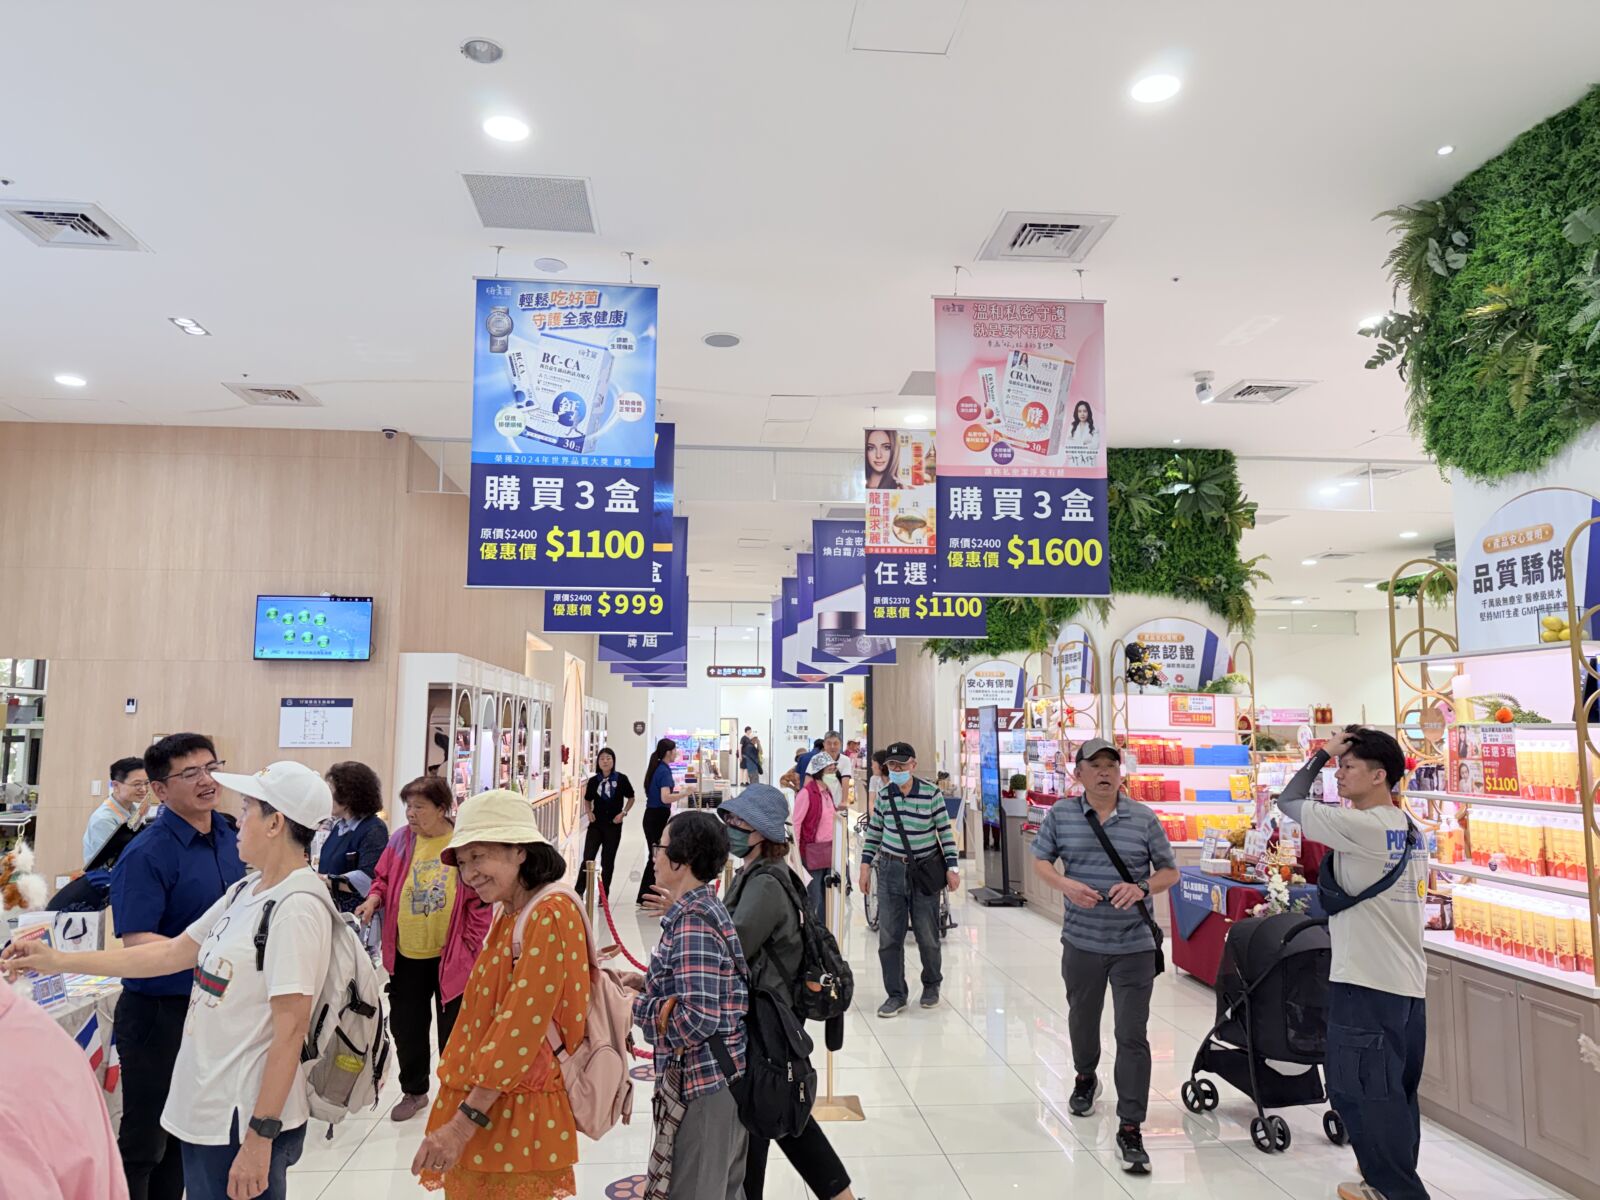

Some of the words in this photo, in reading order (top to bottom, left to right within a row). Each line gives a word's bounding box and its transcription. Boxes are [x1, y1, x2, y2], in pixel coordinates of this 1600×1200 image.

[518, 290, 600, 308] 輕鬆吃好菌
[532, 310, 626, 328] 守護全家健康
[973, 303, 1066, 322] 溫和私密守護
[973, 323, 1066, 339] 就是要不再反覆
[541, 352, 581, 372] BC-CA
[562, 438, 575, 449] 30
[483, 475, 641, 513] 購買3盒
[949, 486, 1095, 522] 購買3盒
[480, 527, 538, 540] 原價$2400
[835, 536, 866, 546] 白金密
[1492, 528, 1543, 549] 產品安心聲明
[479, 542, 537, 561] 優惠價
[545, 525, 645, 562] $1100
[947, 551, 1000, 568] 優惠價
[1007, 535, 1103, 569] $1600
[949, 538, 1001, 549] 原價$2400
[874, 561, 937, 586] 任選
[1473, 547, 1567, 595] 品質驕傲
[553, 593, 593, 603] 原價$2400
[553, 604, 592, 617] 優惠價
[597, 591, 664, 617] $999
[873, 596, 911, 605] 原價$2370
[873, 607, 911, 619] 優惠價
[915, 594, 983, 619] $1100
[1481, 594, 1523, 610] 千萬級無塵室
[1146, 644, 1195, 660] 際認證
[966, 678, 1014, 688] 安心有保障
[1482, 746, 1516, 758] 任選3瓶
[1485, 774, 1518, 792] $1100
